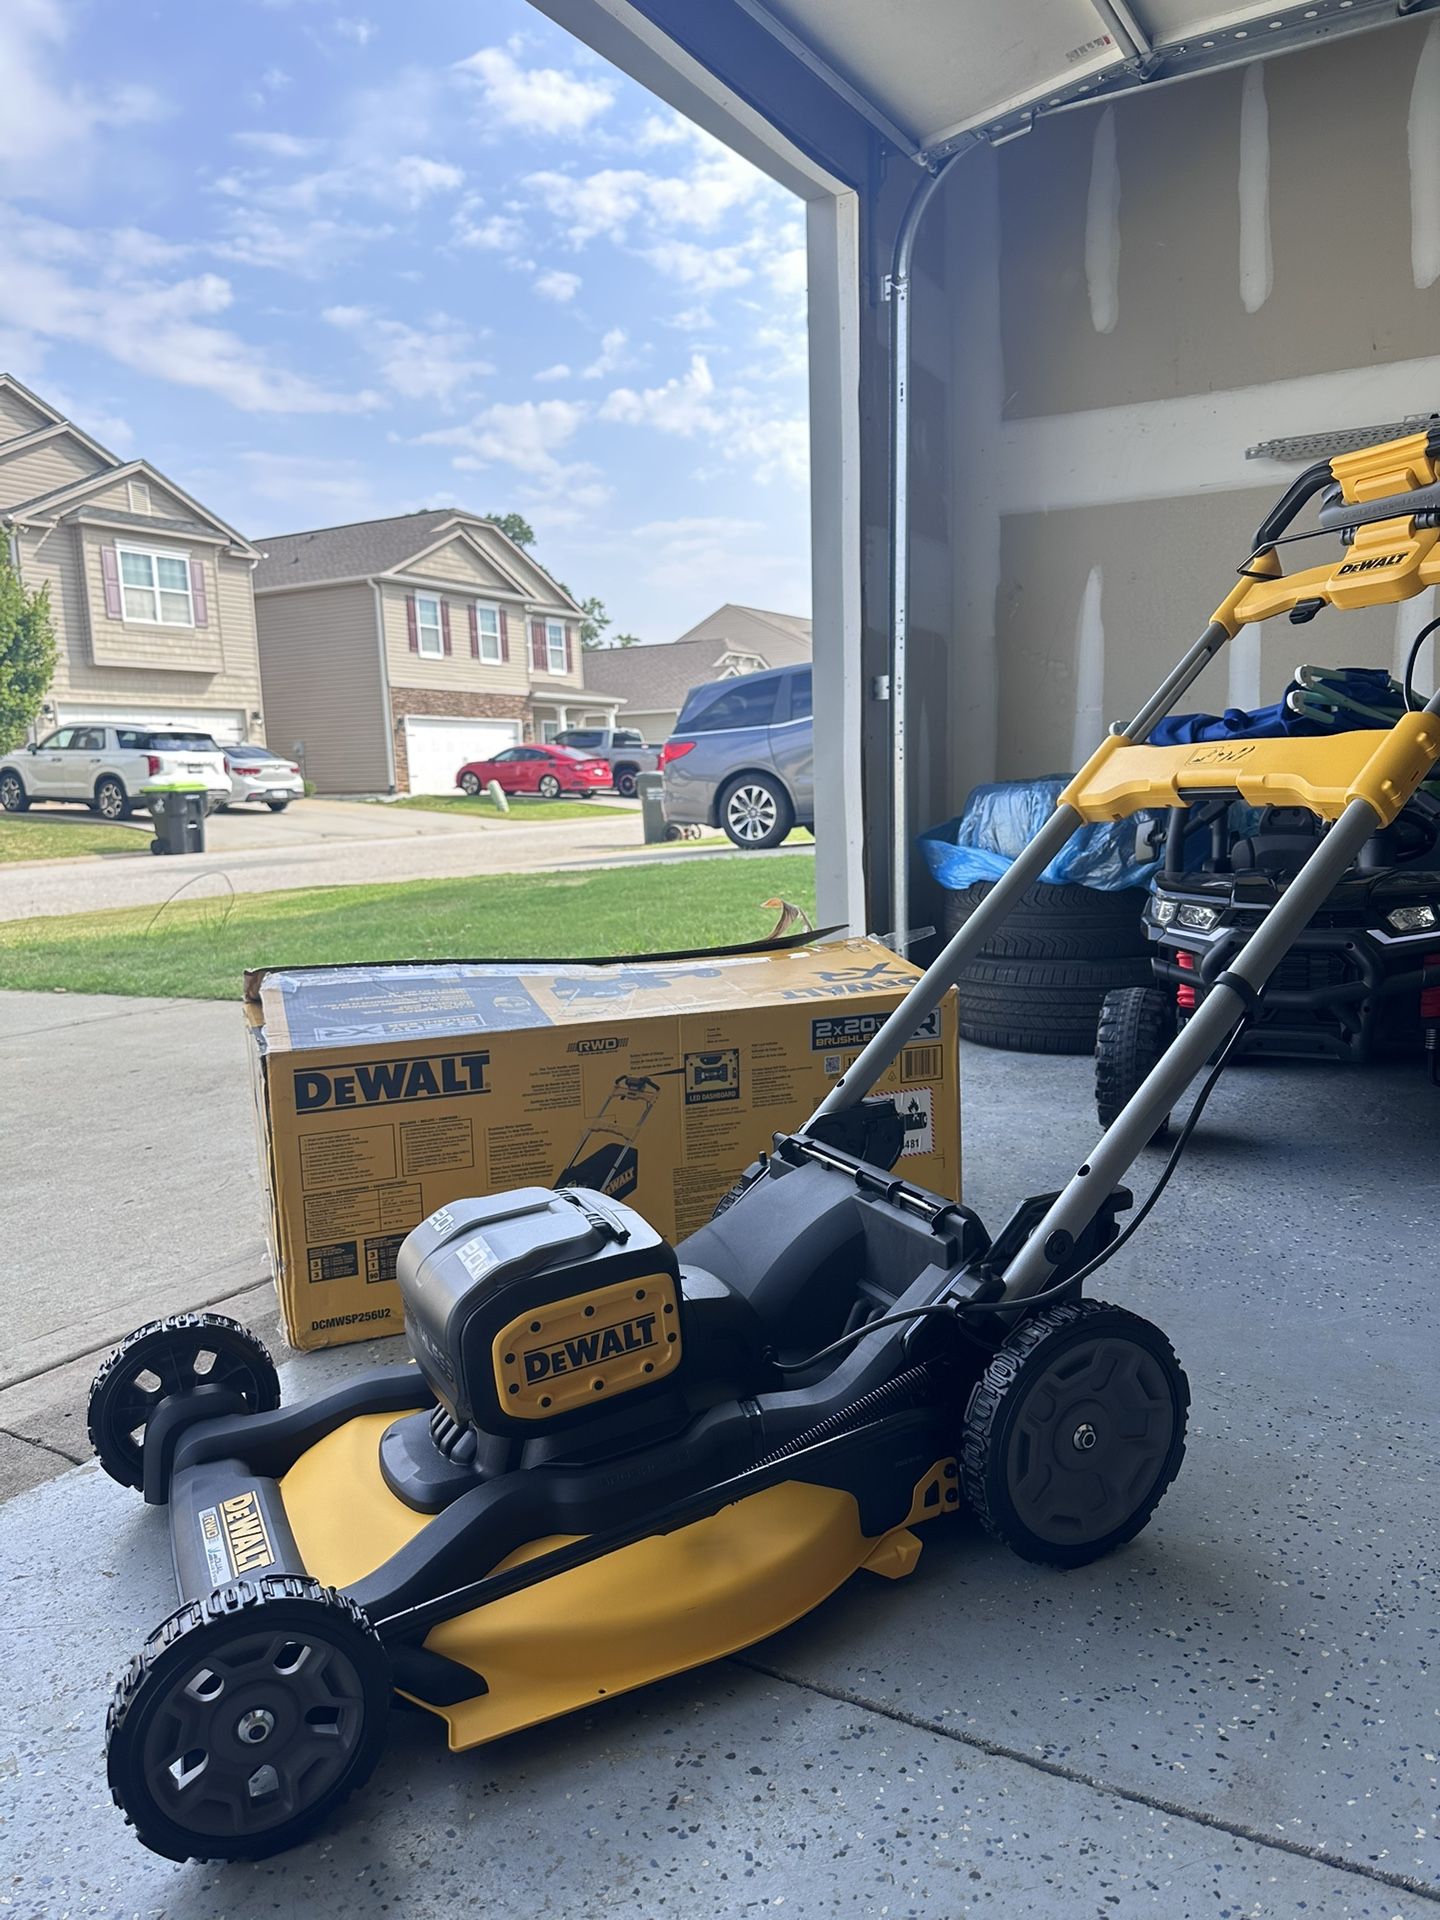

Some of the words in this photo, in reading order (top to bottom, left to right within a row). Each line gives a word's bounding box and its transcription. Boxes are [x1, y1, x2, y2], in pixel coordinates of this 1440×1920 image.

[1337, 551, 1409, 576] DEWALT
[579, 1040, 617, 1051] RWD
[815, 1032, 875, 1047] BRUSHLE
[293, 1054, 490, 1109] DEWALT
[904, 1138, 919, 1149] 481
[312, 1307, 392, 1331] DCMWSP256U2
[524, 1315, 656, 1382] DEWALT
[223, 1491, 272, 1575] DEWALT
